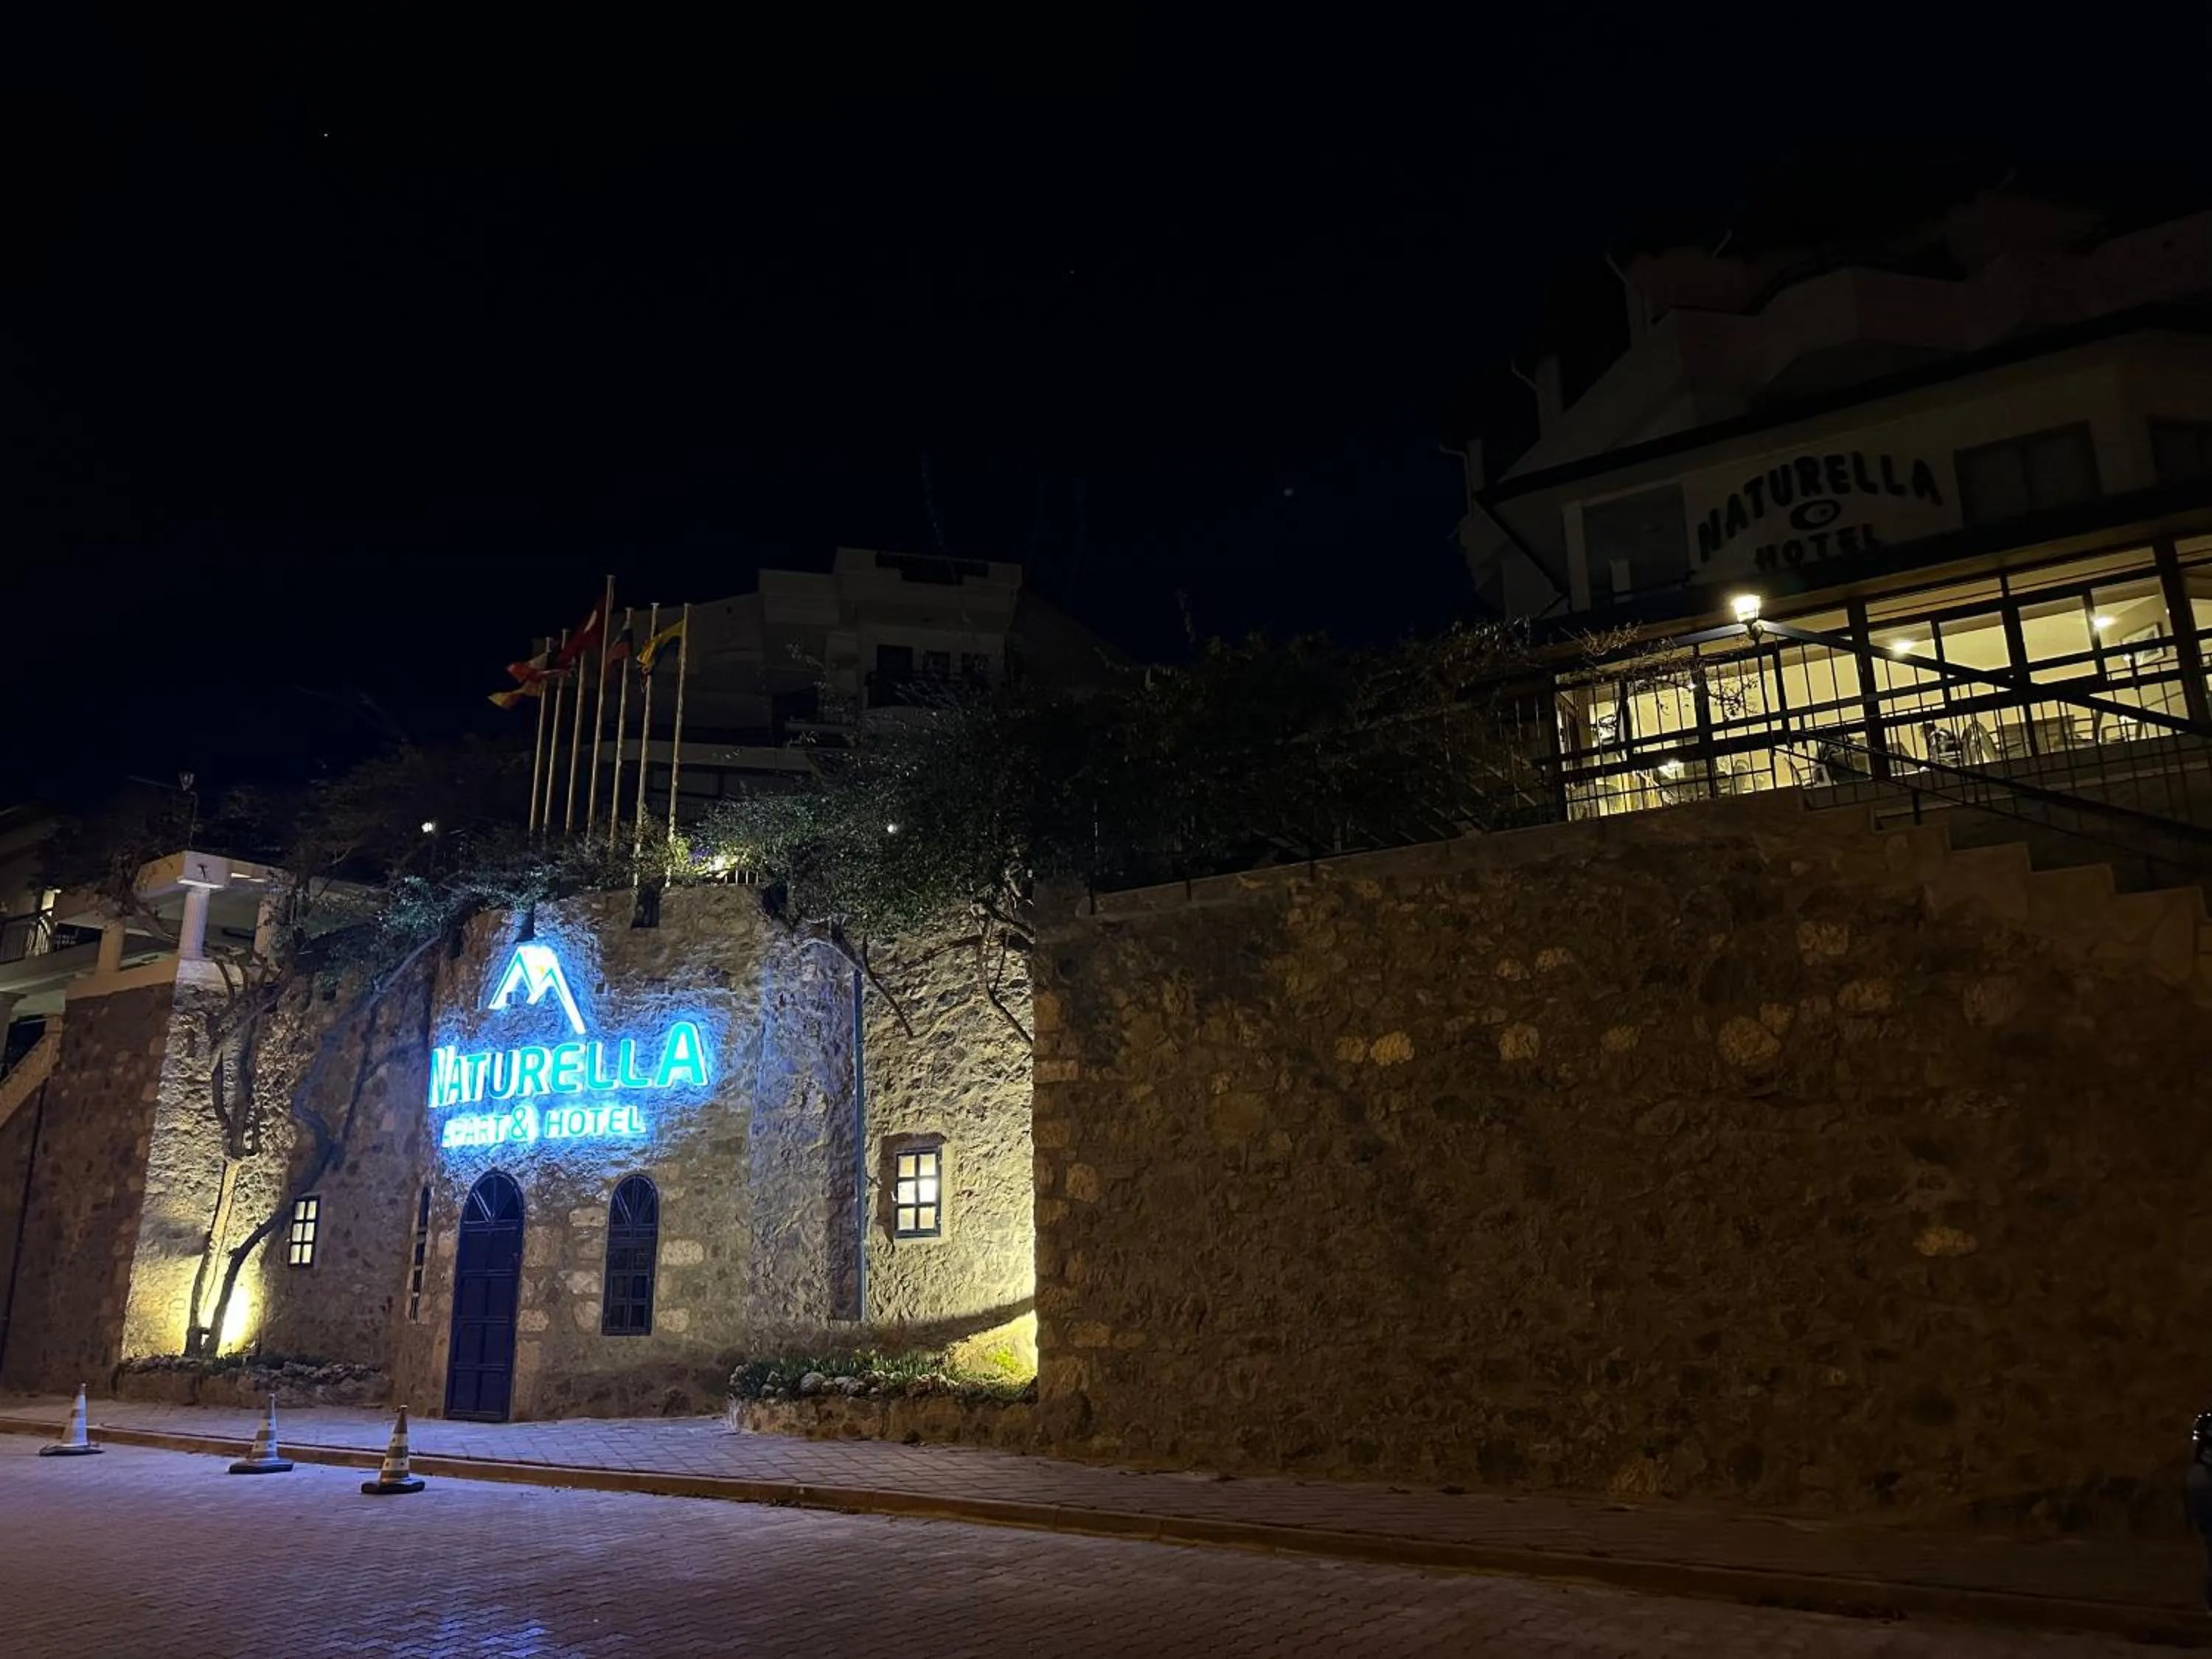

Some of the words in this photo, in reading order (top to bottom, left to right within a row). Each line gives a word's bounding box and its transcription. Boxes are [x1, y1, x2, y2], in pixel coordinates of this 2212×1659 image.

[1698, 451, 1943, 563] NATURELLA
[1754, 524, 1880, 570] HOTEL
[428, 1022, 709, 1108] NATURELLA
[546, 1105, 646, 1139] HOTEL
